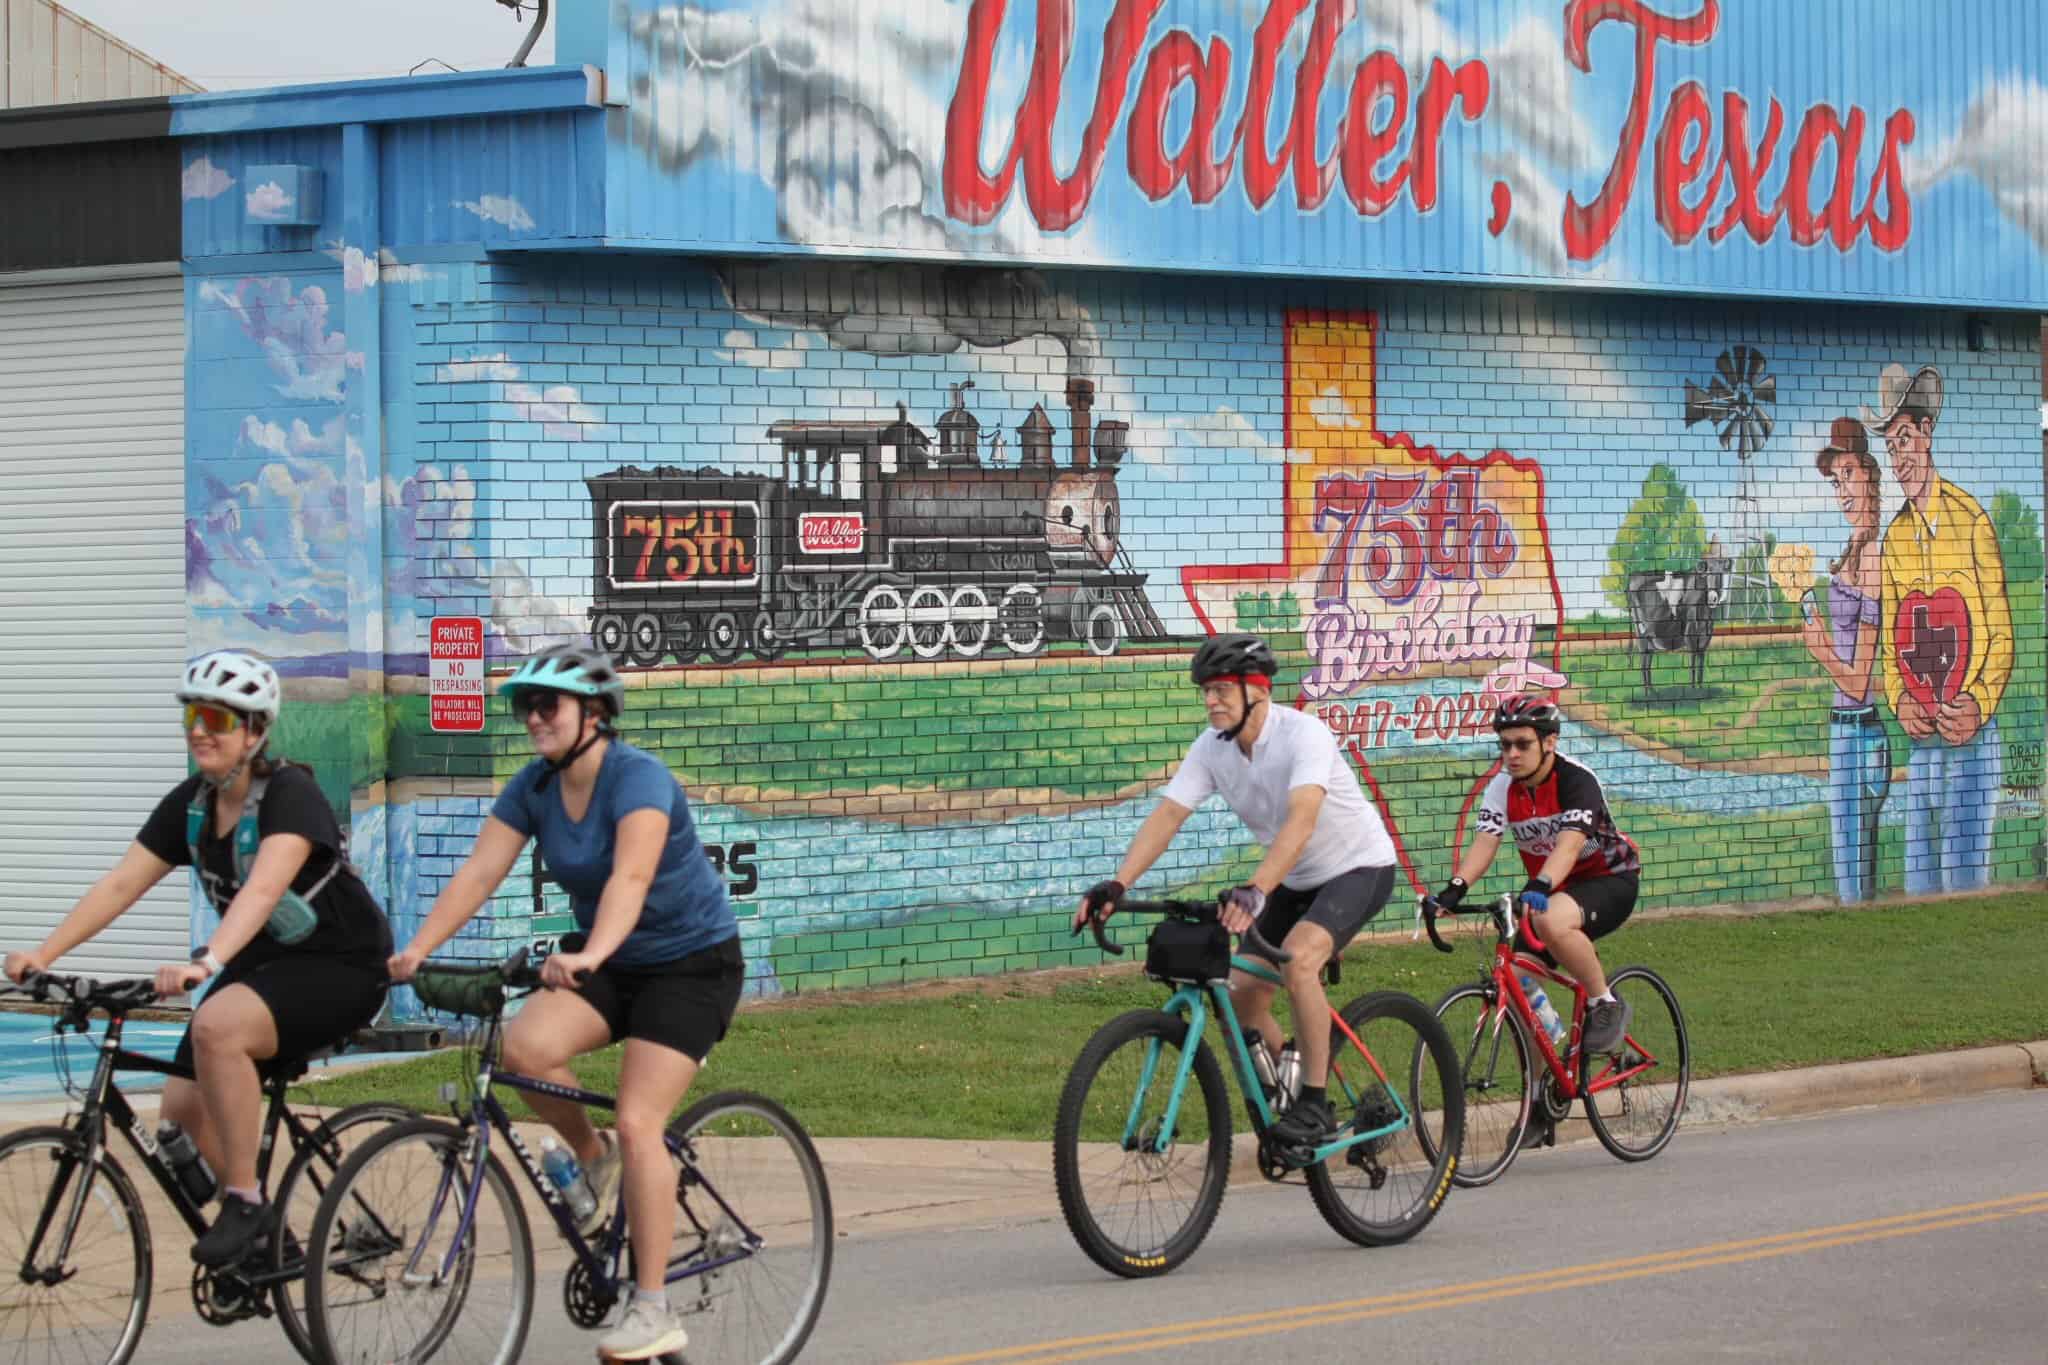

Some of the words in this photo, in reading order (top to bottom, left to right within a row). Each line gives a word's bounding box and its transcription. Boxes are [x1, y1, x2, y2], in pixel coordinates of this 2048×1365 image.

[1563, 0, 1916, 262] Texas
[623, 510, 754, 582] 75th
[1312, 468, 1519, 607] 75th
[433, 642, 480, 656] PROPERTY
[438, 627, 474, 641] PRIVATE
[1301, 580, 1568, 700] Birthday
[433, 679, 482, 692] TRESPASSING
[448, 662, 465, 676] NO
